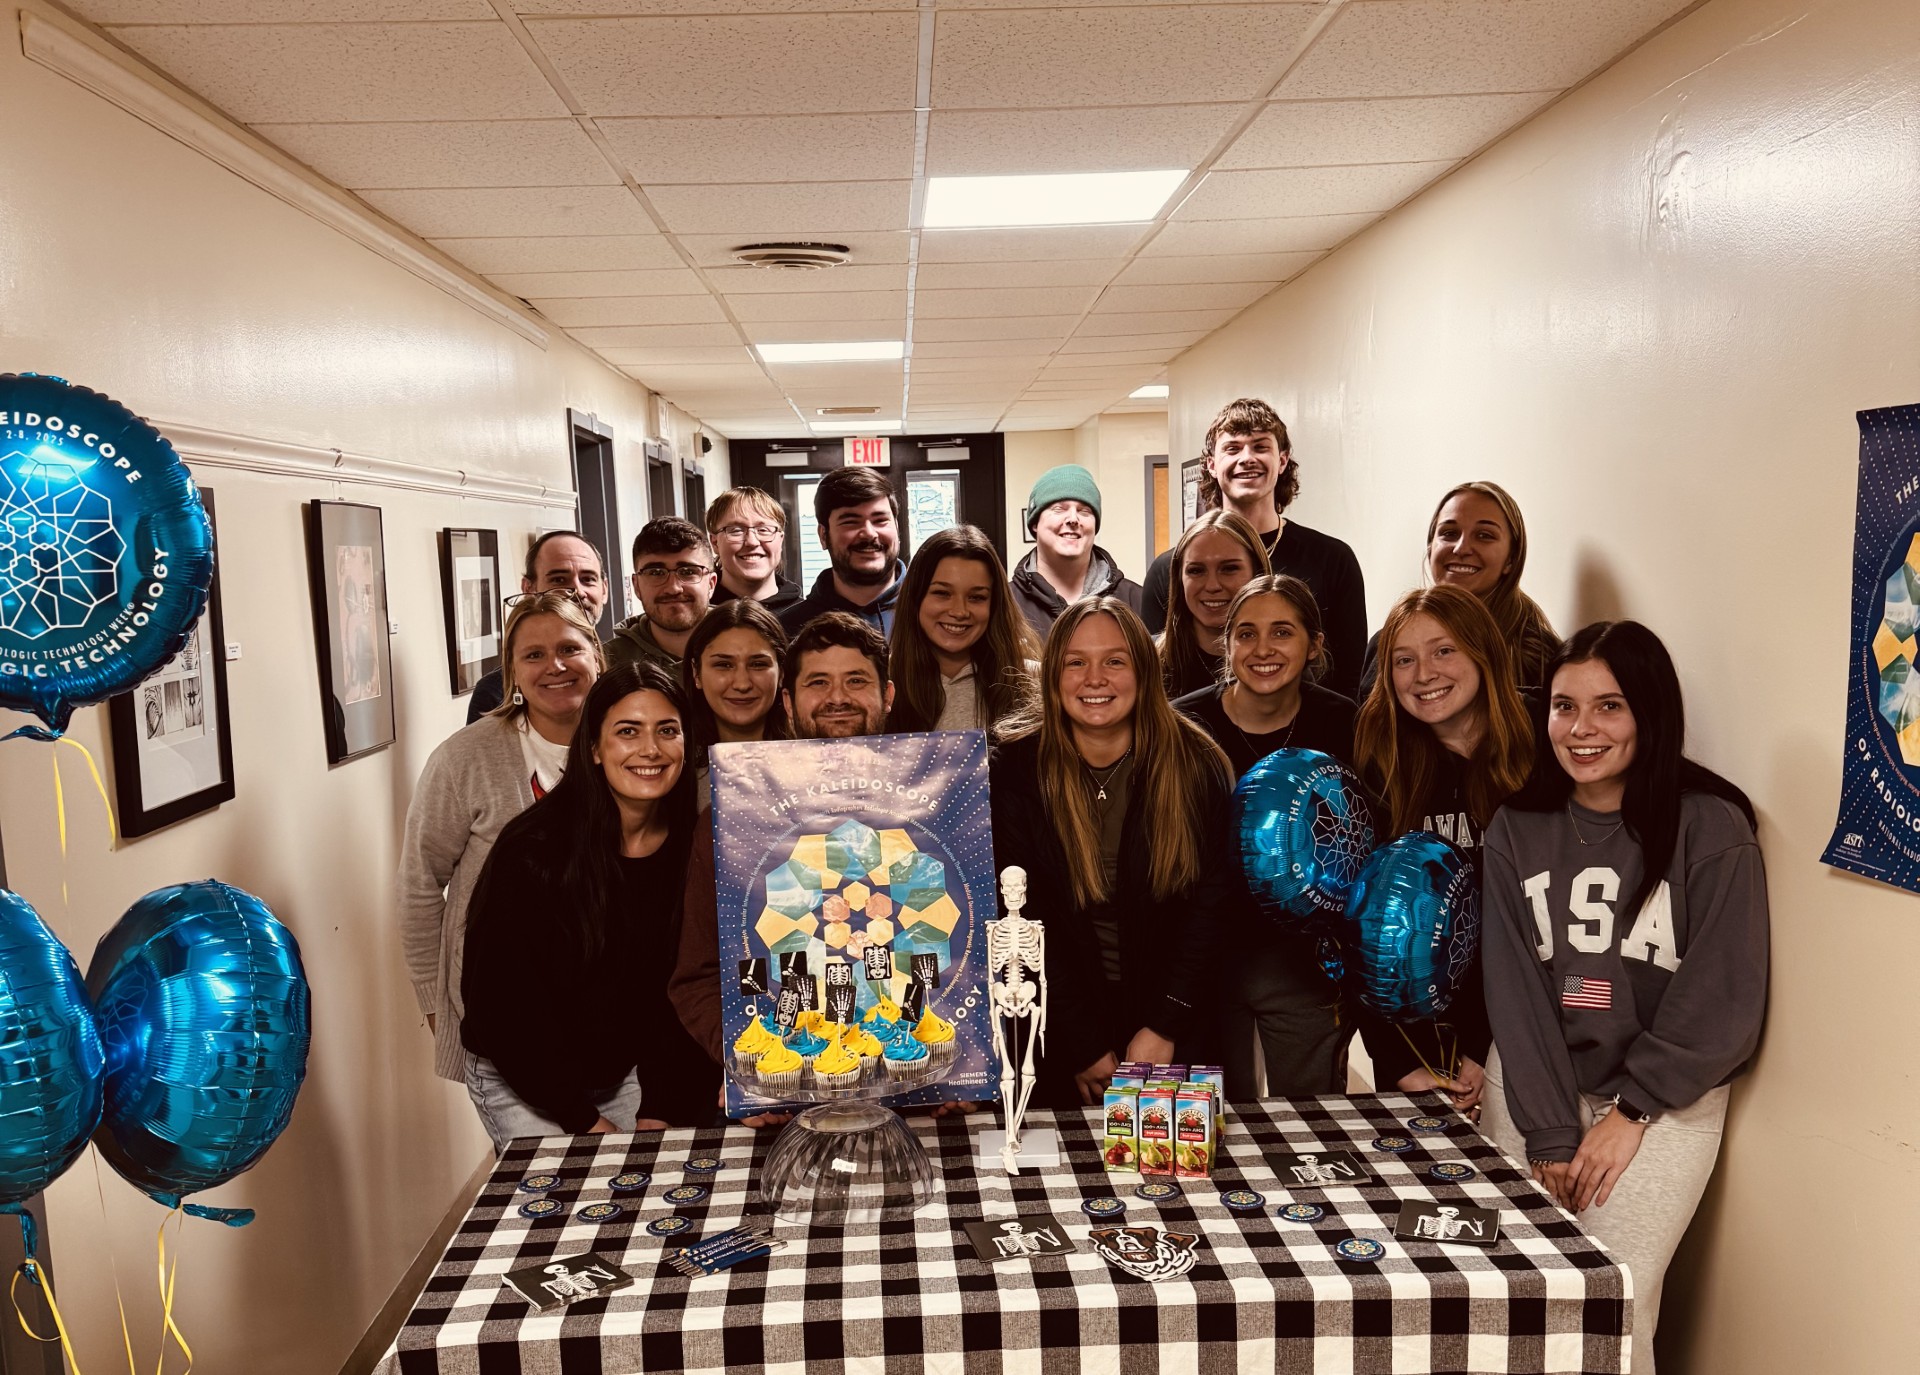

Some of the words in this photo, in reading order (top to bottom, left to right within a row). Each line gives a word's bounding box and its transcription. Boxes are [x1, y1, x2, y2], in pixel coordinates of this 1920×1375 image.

[36, 431, 64, 446] 2025
[853, 439, 883, 463] EXIT
[1895, 475, 1920, 505] THE
[59, 547, 169, 673] TECHNOLOGY
[44, 629, 109, 660] TECHNOLOGY
[1858, 738, 1872, 761] OF
[769, 793, 800, 817] THE
[806, 778, 939, 811] KALEIDOSCOPE
[1097, 790, 1107, 800] A
[1288, 799, 1301, 822] THE
[1878, 819, 1902, 850] NATIONAL
[1292, 863, 1305, 879] OF
[962, 881, 974, 900] Medical
[1430, 922, 1444, 949] THE
[948, 1078, 989, 1087] Healthineers
[960, 1071, 988, 1079] SIEMENS
